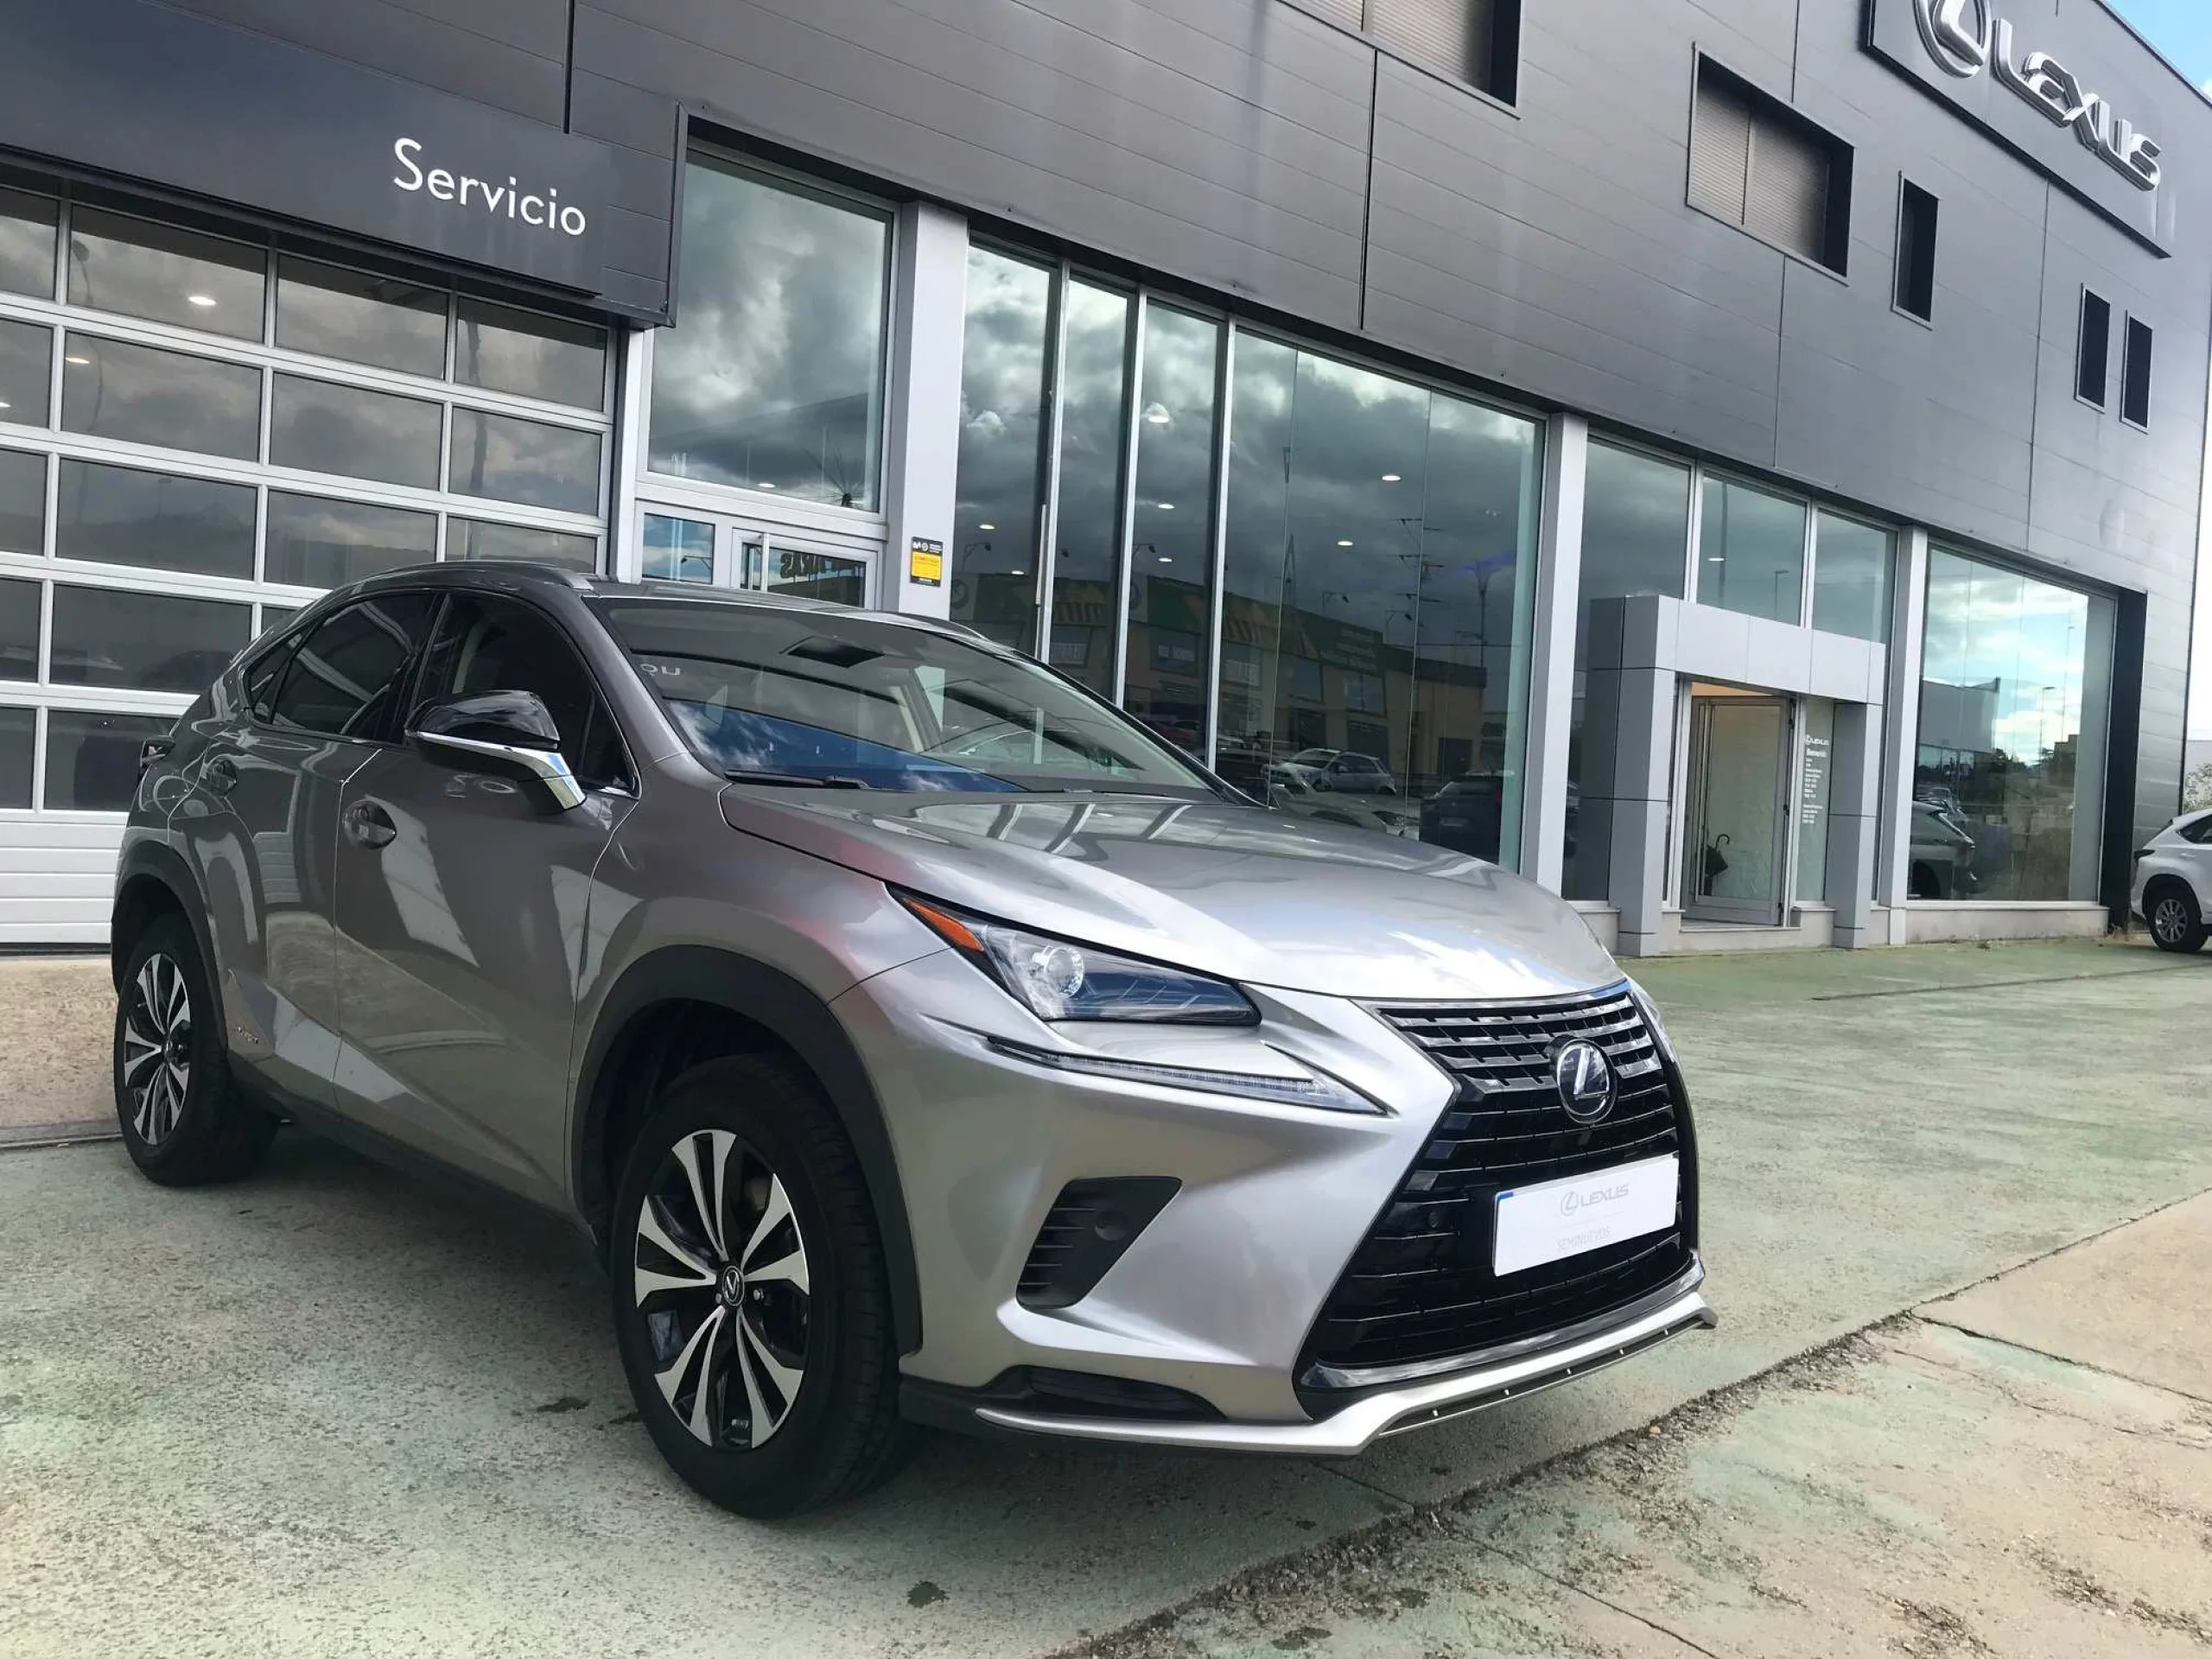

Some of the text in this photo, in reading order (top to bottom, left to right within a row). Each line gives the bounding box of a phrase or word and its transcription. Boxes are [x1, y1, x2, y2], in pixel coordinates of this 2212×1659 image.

[1991, 17, 2162, 192] LEXUS
[393, 137, 587, 236] Servicio
[1580, 1183, 1630, 1208] LEXUS
